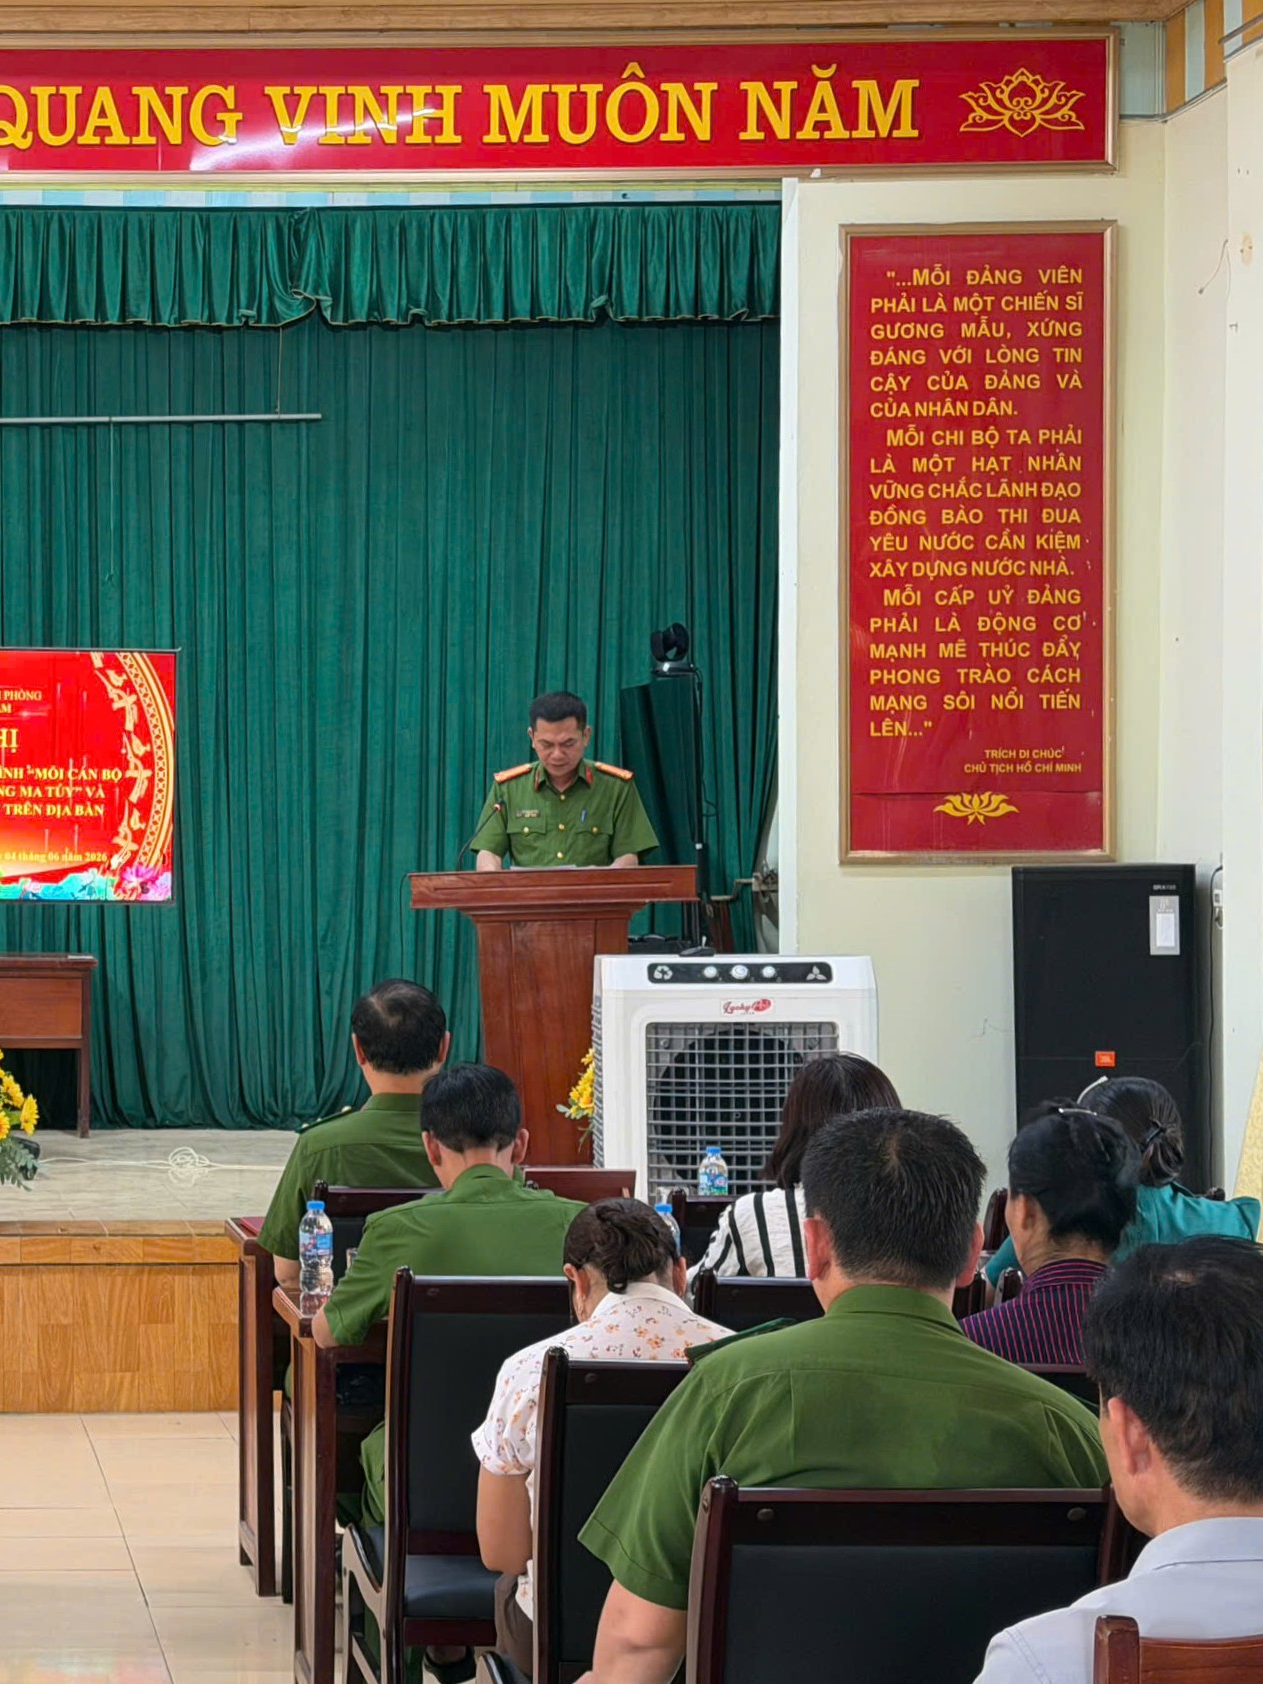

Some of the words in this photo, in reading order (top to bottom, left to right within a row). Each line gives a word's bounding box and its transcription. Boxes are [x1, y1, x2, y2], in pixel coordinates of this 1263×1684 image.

[262, 85, 462, 146] VINH
[483, 63, 717, 144] MUÔN
[740, 65, 919, 139] NĂM
[967, 265, 1022, 284] ĐẢNG
[1039, 266, 1081, 283] VIÊN
[872, 293, 915, 313] PHẢI
[954, 293, 994, 315] MỘT
[1001, 290, 1058, 311] CHIẾN
[871, 323, 944, 339] GƯƠNG
[962, 316, 1010, 338] MẪU,
[1028, 319, 1082, 336] XỨNG
[870, 347, 925, 365] ĐÁNG
[940, 346, 971, 364] VỚI
[986, 344, 1039, 363] LÒNG
[1053, 348, 1081, 362] TIN
[871, 373, 911, 394] CẬY
[928, 371, 968, 390] CỦA
[985, 370, 1040, 389] ĐẢNG
[871, 398, 911, 417] CỦA
[915, 398, 968, 416] NHÂN
[973, 398, 1017, 415] DÂN.
[887, 424, 923, 446] MỖI
[932, 431, 963, 445] CHI
[972, 426, 999, 448] BỘ
[1039, 424, 1081, 444] PHẢI
[913, 454, 955, 476] MỘT
[972, 457, 1011, 475] HẠT
[1029, 453, 1080, 471] NHÂN
[870, 480, 924, 499] VỮNG
[928, 477, 982, 498] CHẮC
[987, 479, 1037, 497] LÃNH
[1041, 483, 1081, 500] ĐẠO
[870, 505, 926, 525] ĐỒNG
[942, 505, 983, 524] BÀO
[998, 509, 1027, 523] THI
[1042, 509, 1081, 523] ĐUA
[870, 533, 907, 551] YÊU
[920, 531, 973, 550] NƯỚC
[986, 529, 1025, 549] CẦN
[1037, 531, 1080, 553] KIỆM
[870, 559, 908, 577] XÂY
[913, 560, 967, 580] DỰNG
[972, 557, 1025, 576] NƯỚC
[1030, 556, 1074, 575] NHÀ.
[884, 584, 920, 606] MỖI
[935, 585, 974, 605] CẤP
[989, 585, 1013, 604] UỶ
[1027, 585, 1080, 604] ĐẢNG
[870, 613, 917, 632] PHẢI
[978, 612, 1036, 634] ĐỘNG
[870, 644, 925, 662] MẠNH
[939, 639, 966, 657] MẼ
[979, 639, 1030, 657] THÚC
[1043, 635, 1081, 659] ĐẨY
[870, 669, 940, 684] PHONG
[957, 663, 1010, 683] TRÀO
[1027, 665, 1080, 683] CÁCH
[871, 695, 927, 714] MẠNG
[944, 691, 974, 709] SÔI
[992, 687, 1023, 709] NỔI
[1040, 689, 1080, 709] TIẾN
[984, 747, 1016, 759] TRÍCH
[1019, 749, 1030, 759] DI
[1032, 748, 1063, 759] CHÚC
[102, 767, 122, 783] BỘ
[990, 763, 1014, 775] TỊCH
[1035, 761, 1053, 773] CHÍ
[1055, 763, 1082, 773] MINH
[20, 786, 42, 797] MA
[86, 784, 105, 798] VÀ
[4, 802, 43, 815] TRÊN
[47, 805, 72, 818] ĐỊA
[75, 803, 104, 816] BÀN
